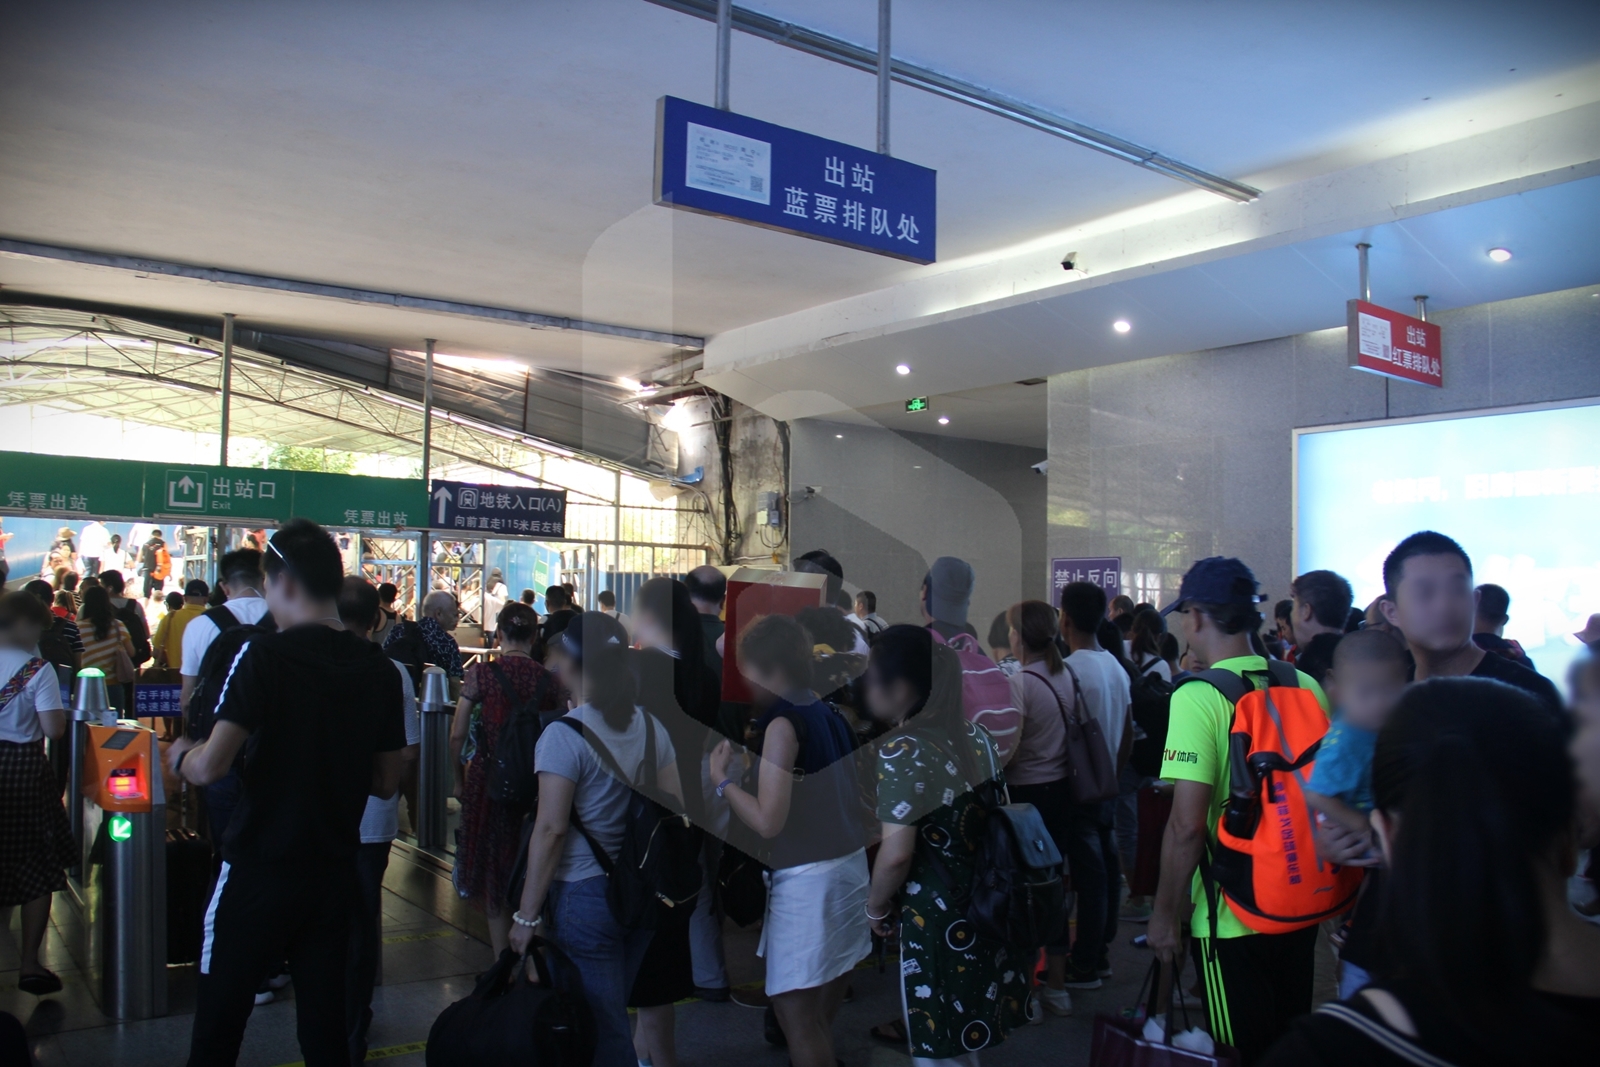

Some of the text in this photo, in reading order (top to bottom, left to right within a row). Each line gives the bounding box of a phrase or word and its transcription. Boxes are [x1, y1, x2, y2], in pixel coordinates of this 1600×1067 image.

[824, 156, 876, 194] 出站
[783, 186, 920, 245] 蓝票排队处
[1406, 325, 1426, 347] 出站
[1392, 346, 1440, 377] 红票排队处
[212, 477, 276, 499] 出站口
[7, 491, 88, 511] 凭票出站
[212, 501, 231, 510] Exit
[480, 492, 562, 513] 地铁入口(A)
[344, 509, 408, 526] 凭票出站
[454, 515, 563, 534] 向前直走115米后左转
